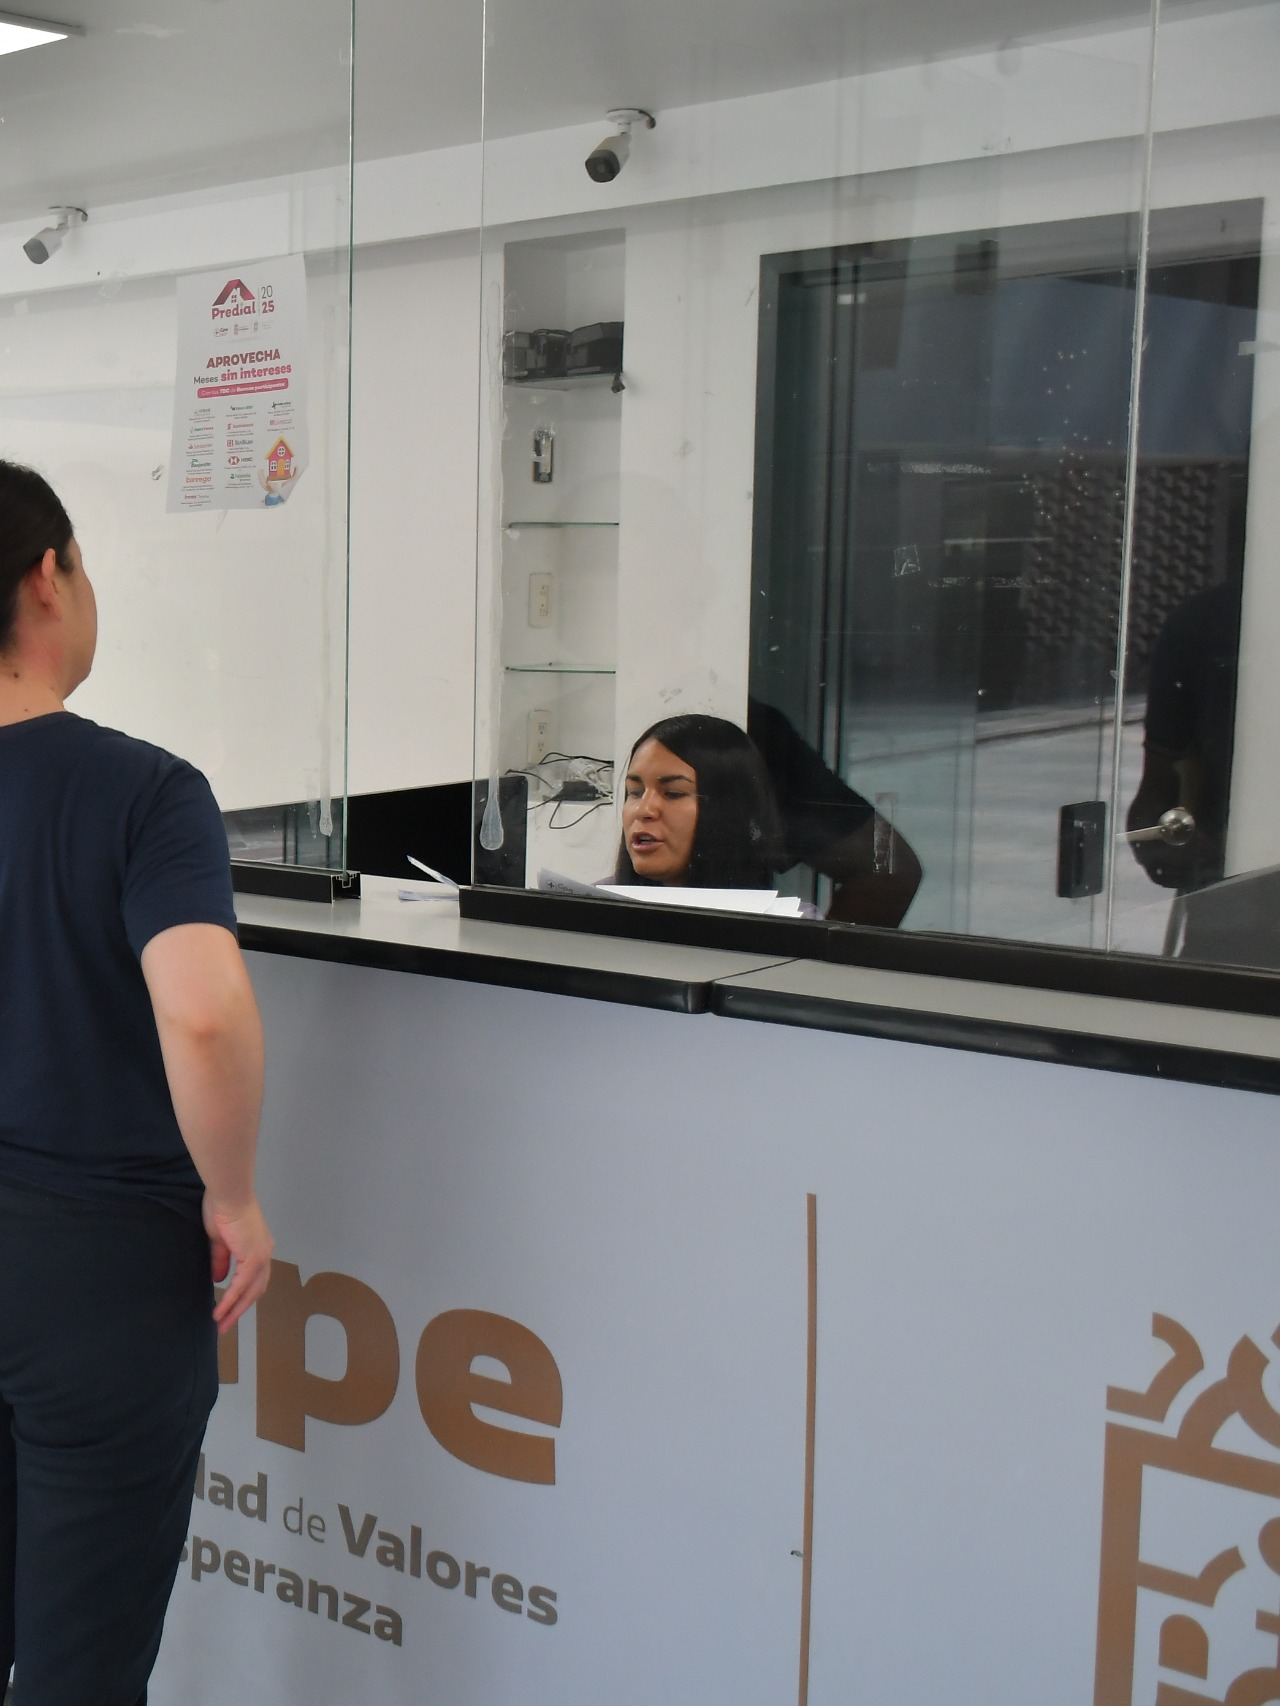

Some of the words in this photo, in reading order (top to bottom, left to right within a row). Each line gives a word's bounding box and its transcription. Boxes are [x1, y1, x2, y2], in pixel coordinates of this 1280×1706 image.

[261, 285, 273, 299] 20
[211, 301, 256, 320] Predial
[261, 300, 275, 314] 25
[206, 348, 281, 369] APROVECHA
[193, 376, 219, 385] Meses
[221, 369, 238, 382] sin
[240, 364, 292, 379] intereses
[282, 1497, 327, 1544] de
[337, 1503, 559, 1627] Valores
